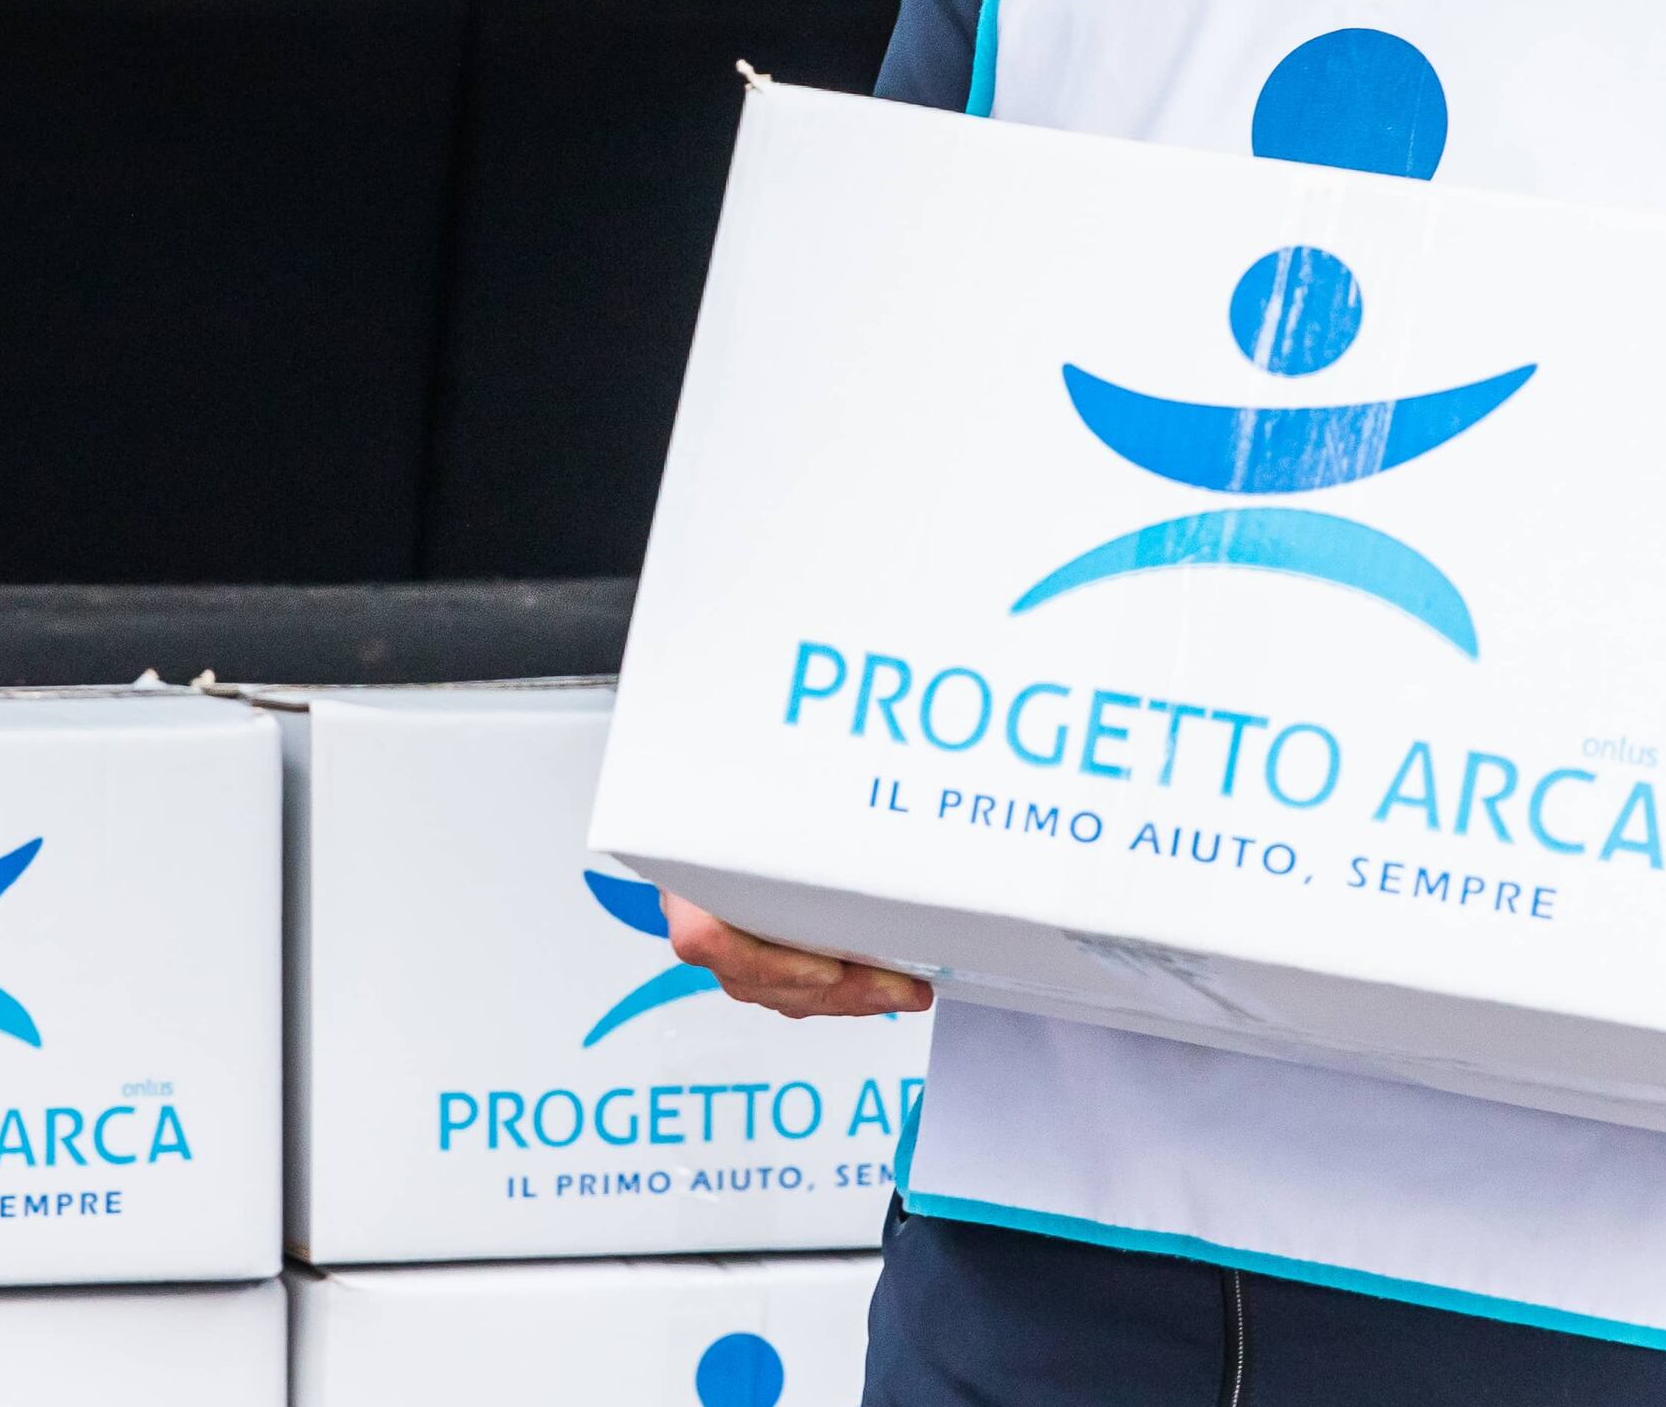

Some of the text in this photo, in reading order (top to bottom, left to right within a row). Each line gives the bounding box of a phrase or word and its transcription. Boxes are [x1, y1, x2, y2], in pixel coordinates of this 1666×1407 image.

[784, 641, 1664, 871] PROGETTO ARCA
[1582, 735, 1660, 767] onlus
[869, 778, 1555, 919] IL PRIMO AIUTO, SEMPRE
[122, 1079, 173, 1097] onlus
[438, 1080, 824, 1153] PROGETTO
[508, 1163, 896, 1199] IL PRIMO AIUTO, SEM
